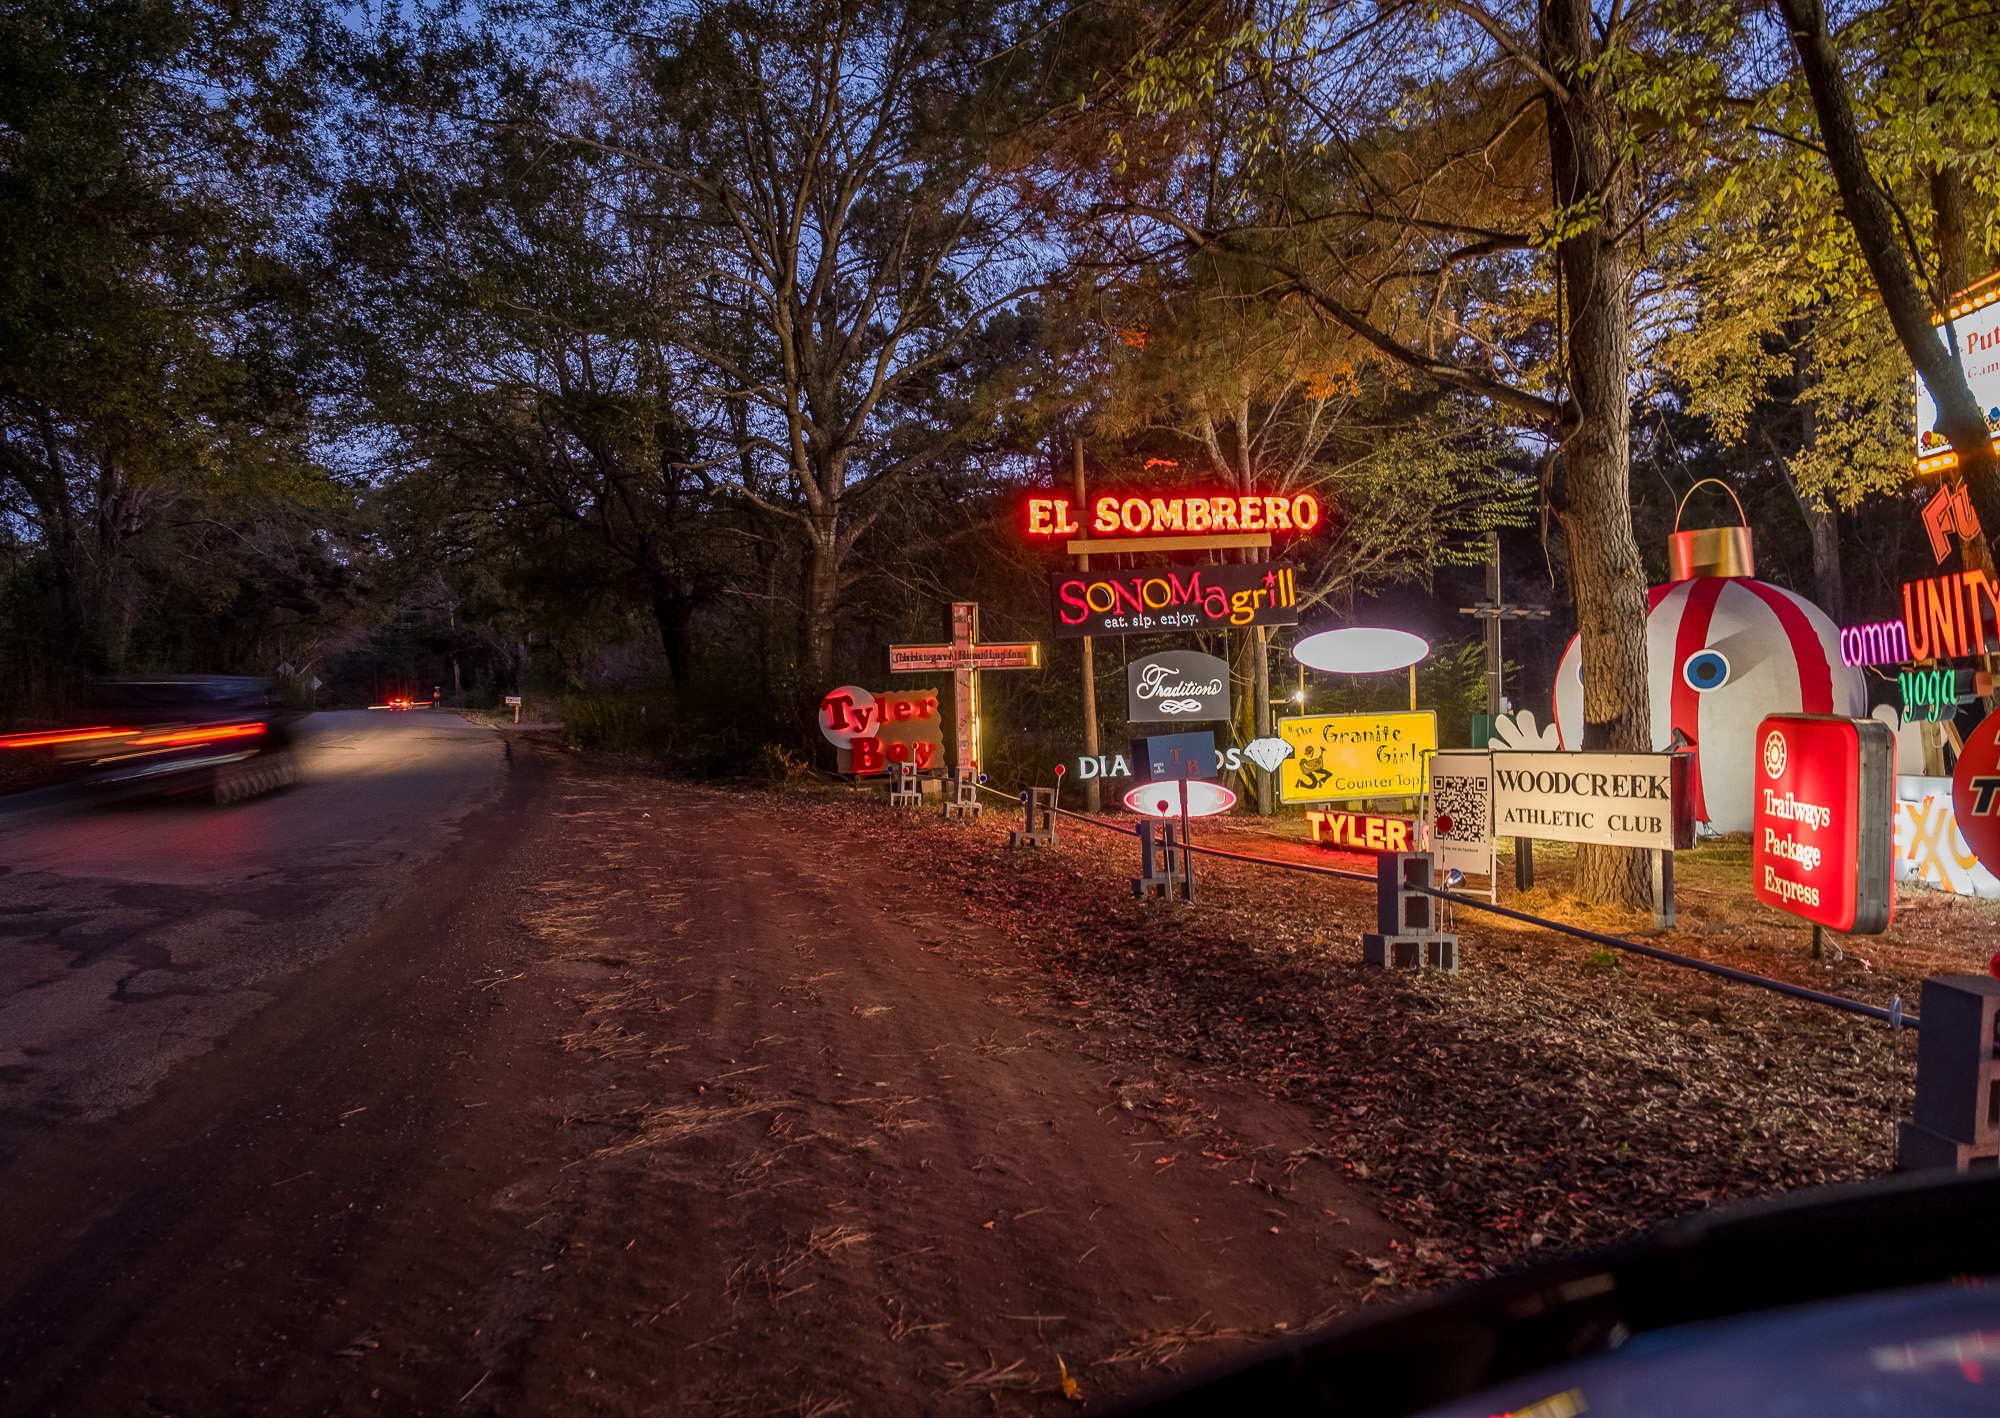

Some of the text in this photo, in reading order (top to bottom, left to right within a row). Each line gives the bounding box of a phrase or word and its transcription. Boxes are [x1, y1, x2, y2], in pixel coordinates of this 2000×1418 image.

[1028, 494, 1319, 534] EL SOMBRERO
[1104, 611, 1199, 630] eat. sip. enjoy.
[895, 651, 928, 663] Christ
[1136, 663, 1223, 700] Traditions
[1898, 668, 1957, 723] yoga
[821, 693, 937, 733] Tyler
[1322, 723, 1402, 744] Granite
[849, 736, 937, 774] Boy
[1495, 769, 1671, 800] WOODCREEK
[1504, 807, 1662, 834] ATHLETIC CLUB
[1763, 788, 1831, 832] Trailways
[1306, 810, 1409, 853] TYLER
[1764, 827, 1822, 872] Package
[1764, 864, 1820, 908] Express
